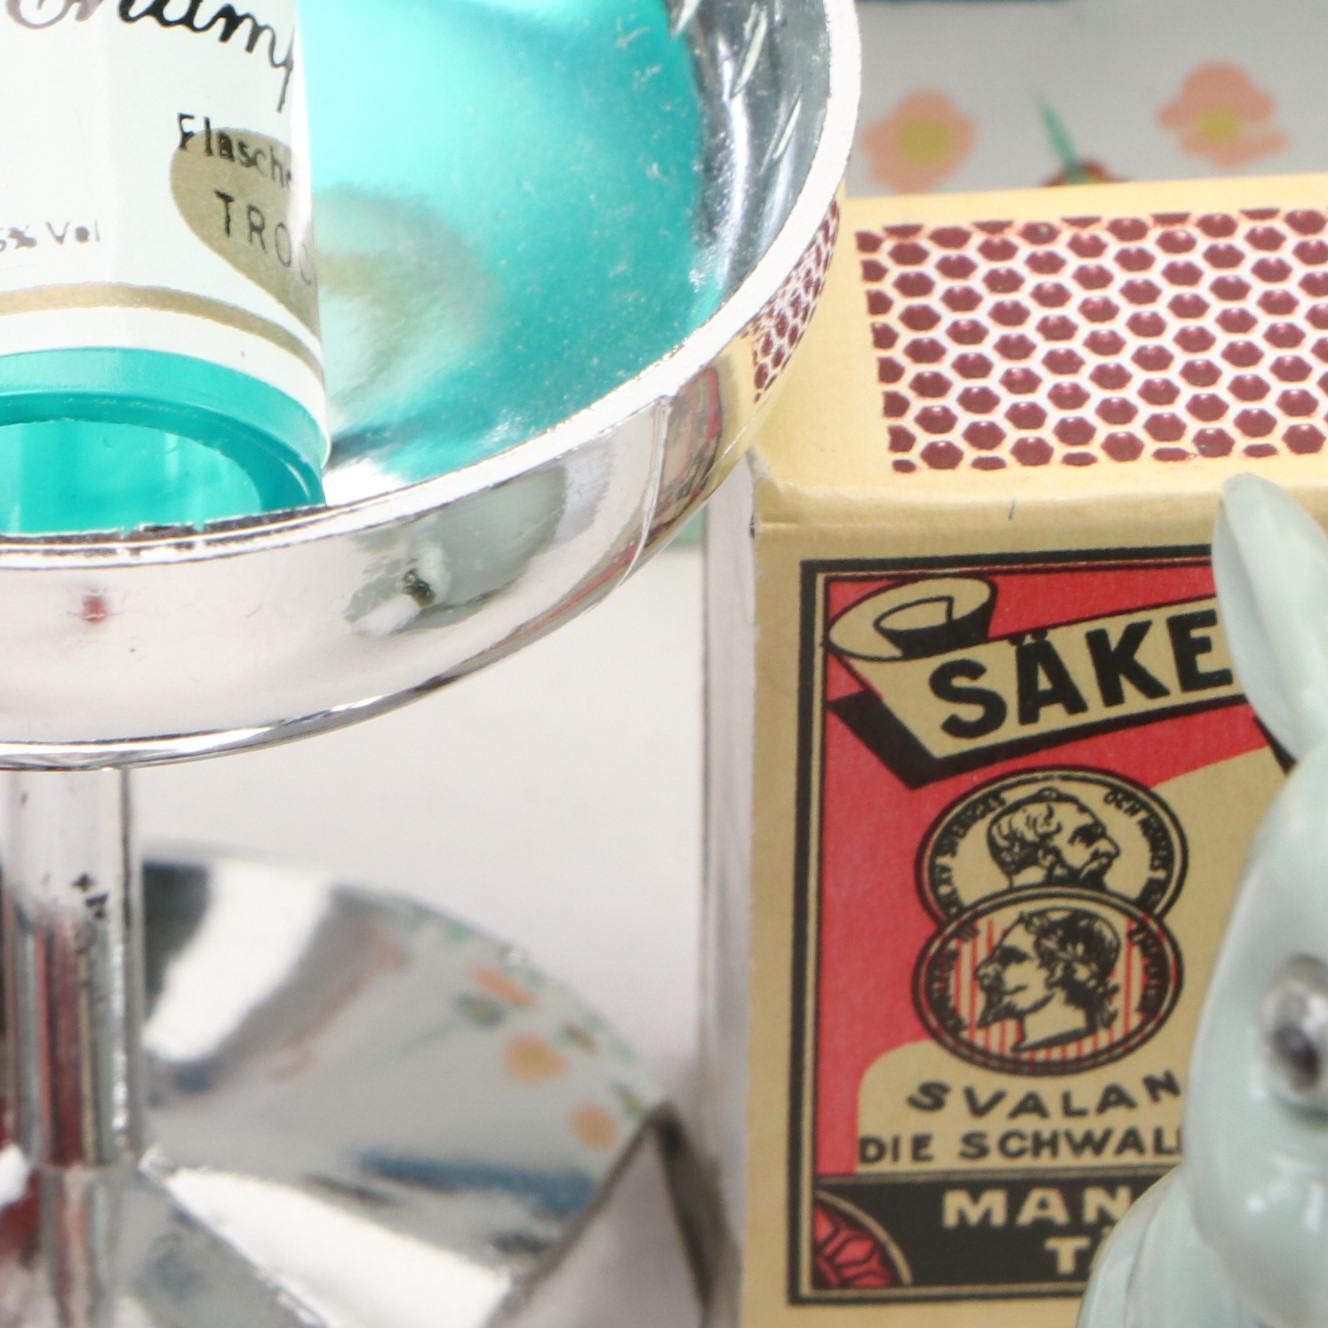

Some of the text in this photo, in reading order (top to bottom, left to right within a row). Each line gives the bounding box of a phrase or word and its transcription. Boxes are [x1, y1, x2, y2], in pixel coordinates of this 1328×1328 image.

[928, 608, 1234, 740] SÄKE
[906, 1070, 1181, 1119] SVALAN
[859, 1134, 935, 1164] DIE
